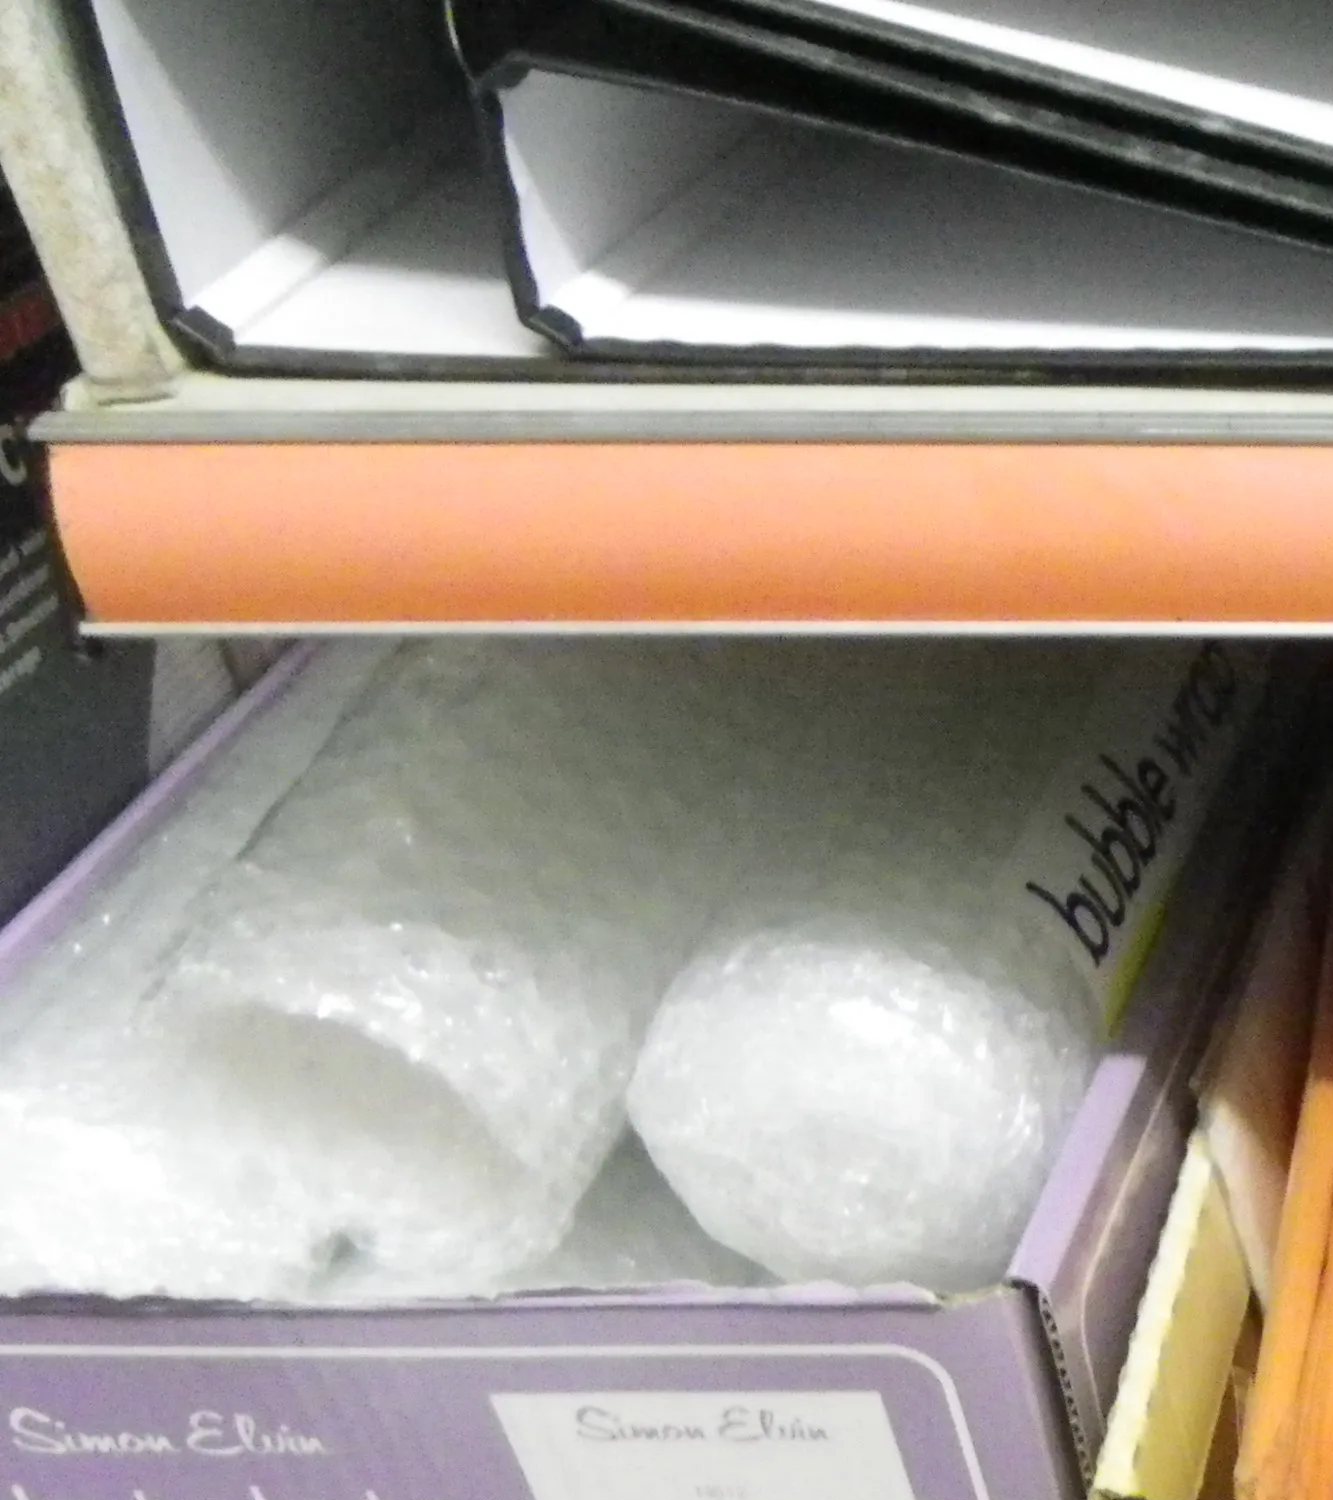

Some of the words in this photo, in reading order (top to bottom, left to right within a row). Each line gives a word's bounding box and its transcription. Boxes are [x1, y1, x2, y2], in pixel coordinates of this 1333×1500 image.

[1026, 752, 1178, 968] bubble
[8, 1406, 182, 1456] Simon
[186, 1410, 328, 1456] Elvin
[575, 1405, 706, 1442] Simon
